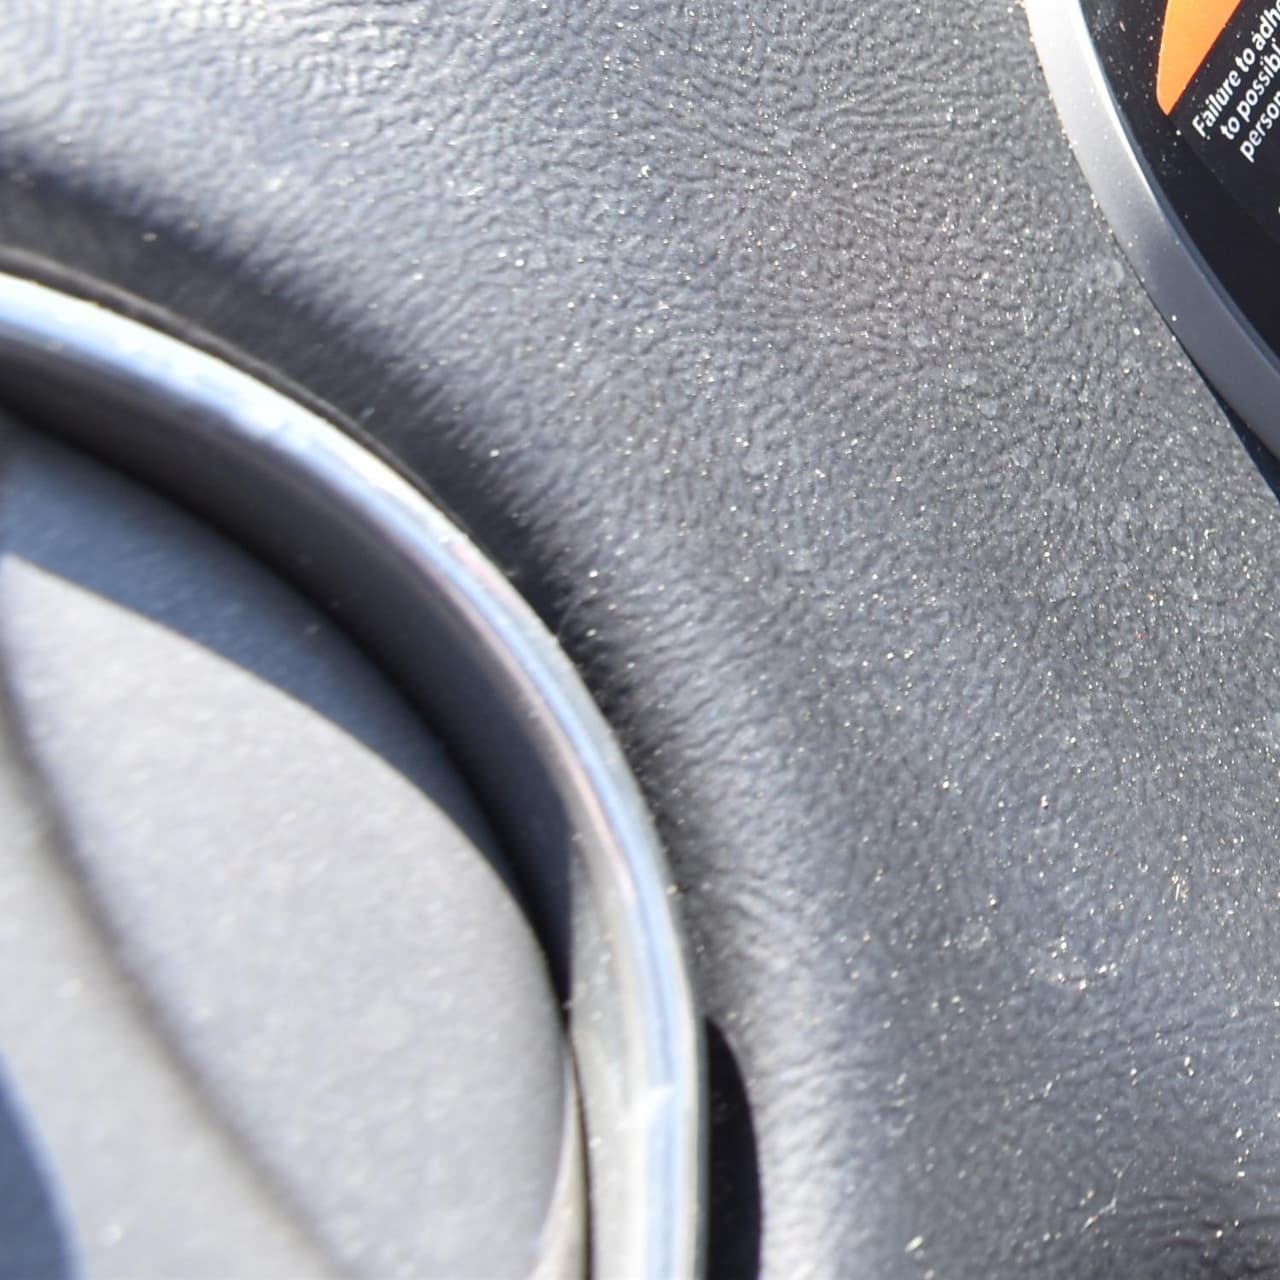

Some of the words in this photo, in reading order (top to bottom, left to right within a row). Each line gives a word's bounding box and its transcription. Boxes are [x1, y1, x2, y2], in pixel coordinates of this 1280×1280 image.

[1191, 69, 1243, 139] Failure
[1233, 46, 1257, 74] to
[1218, 115, 1242, 141] to
